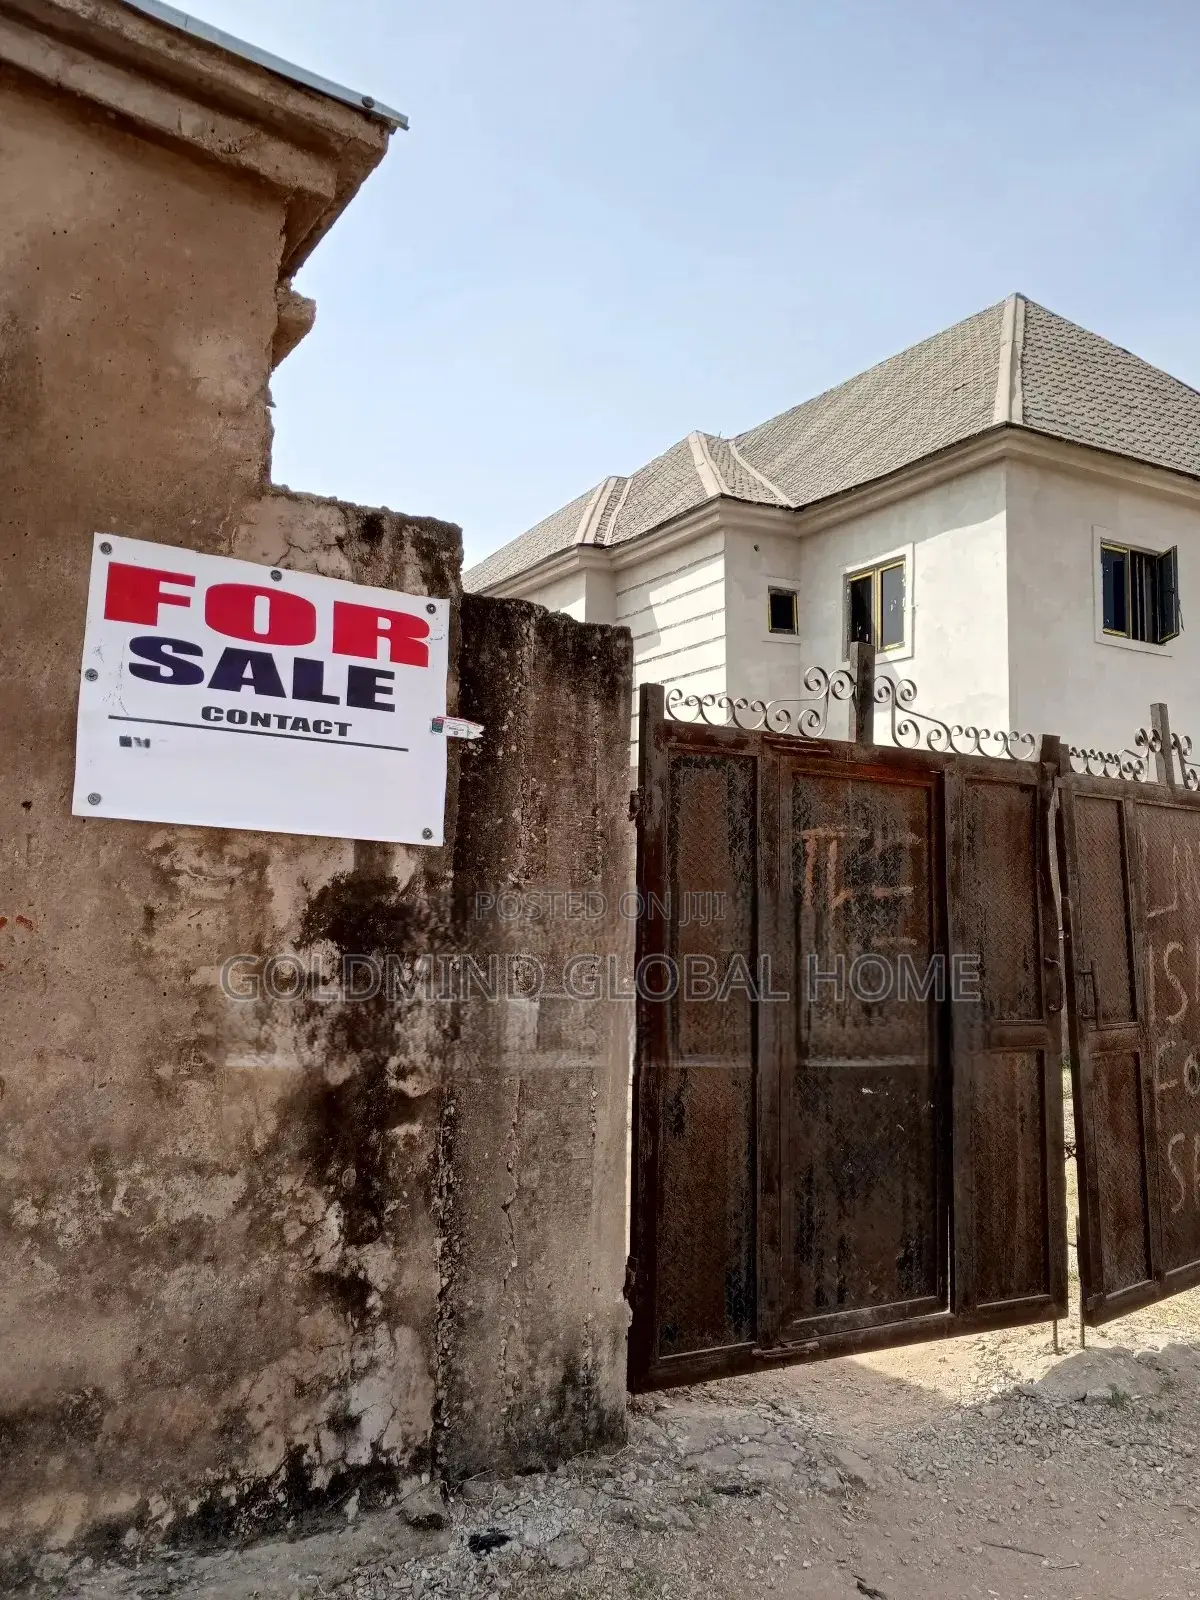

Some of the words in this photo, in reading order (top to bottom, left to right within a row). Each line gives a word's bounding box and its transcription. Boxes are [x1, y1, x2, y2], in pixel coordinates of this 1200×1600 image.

[104, 561, 431, 668] FOR
[128, 635, 396, 712] SALE
[201, 705, 353, 737] CONTACT
